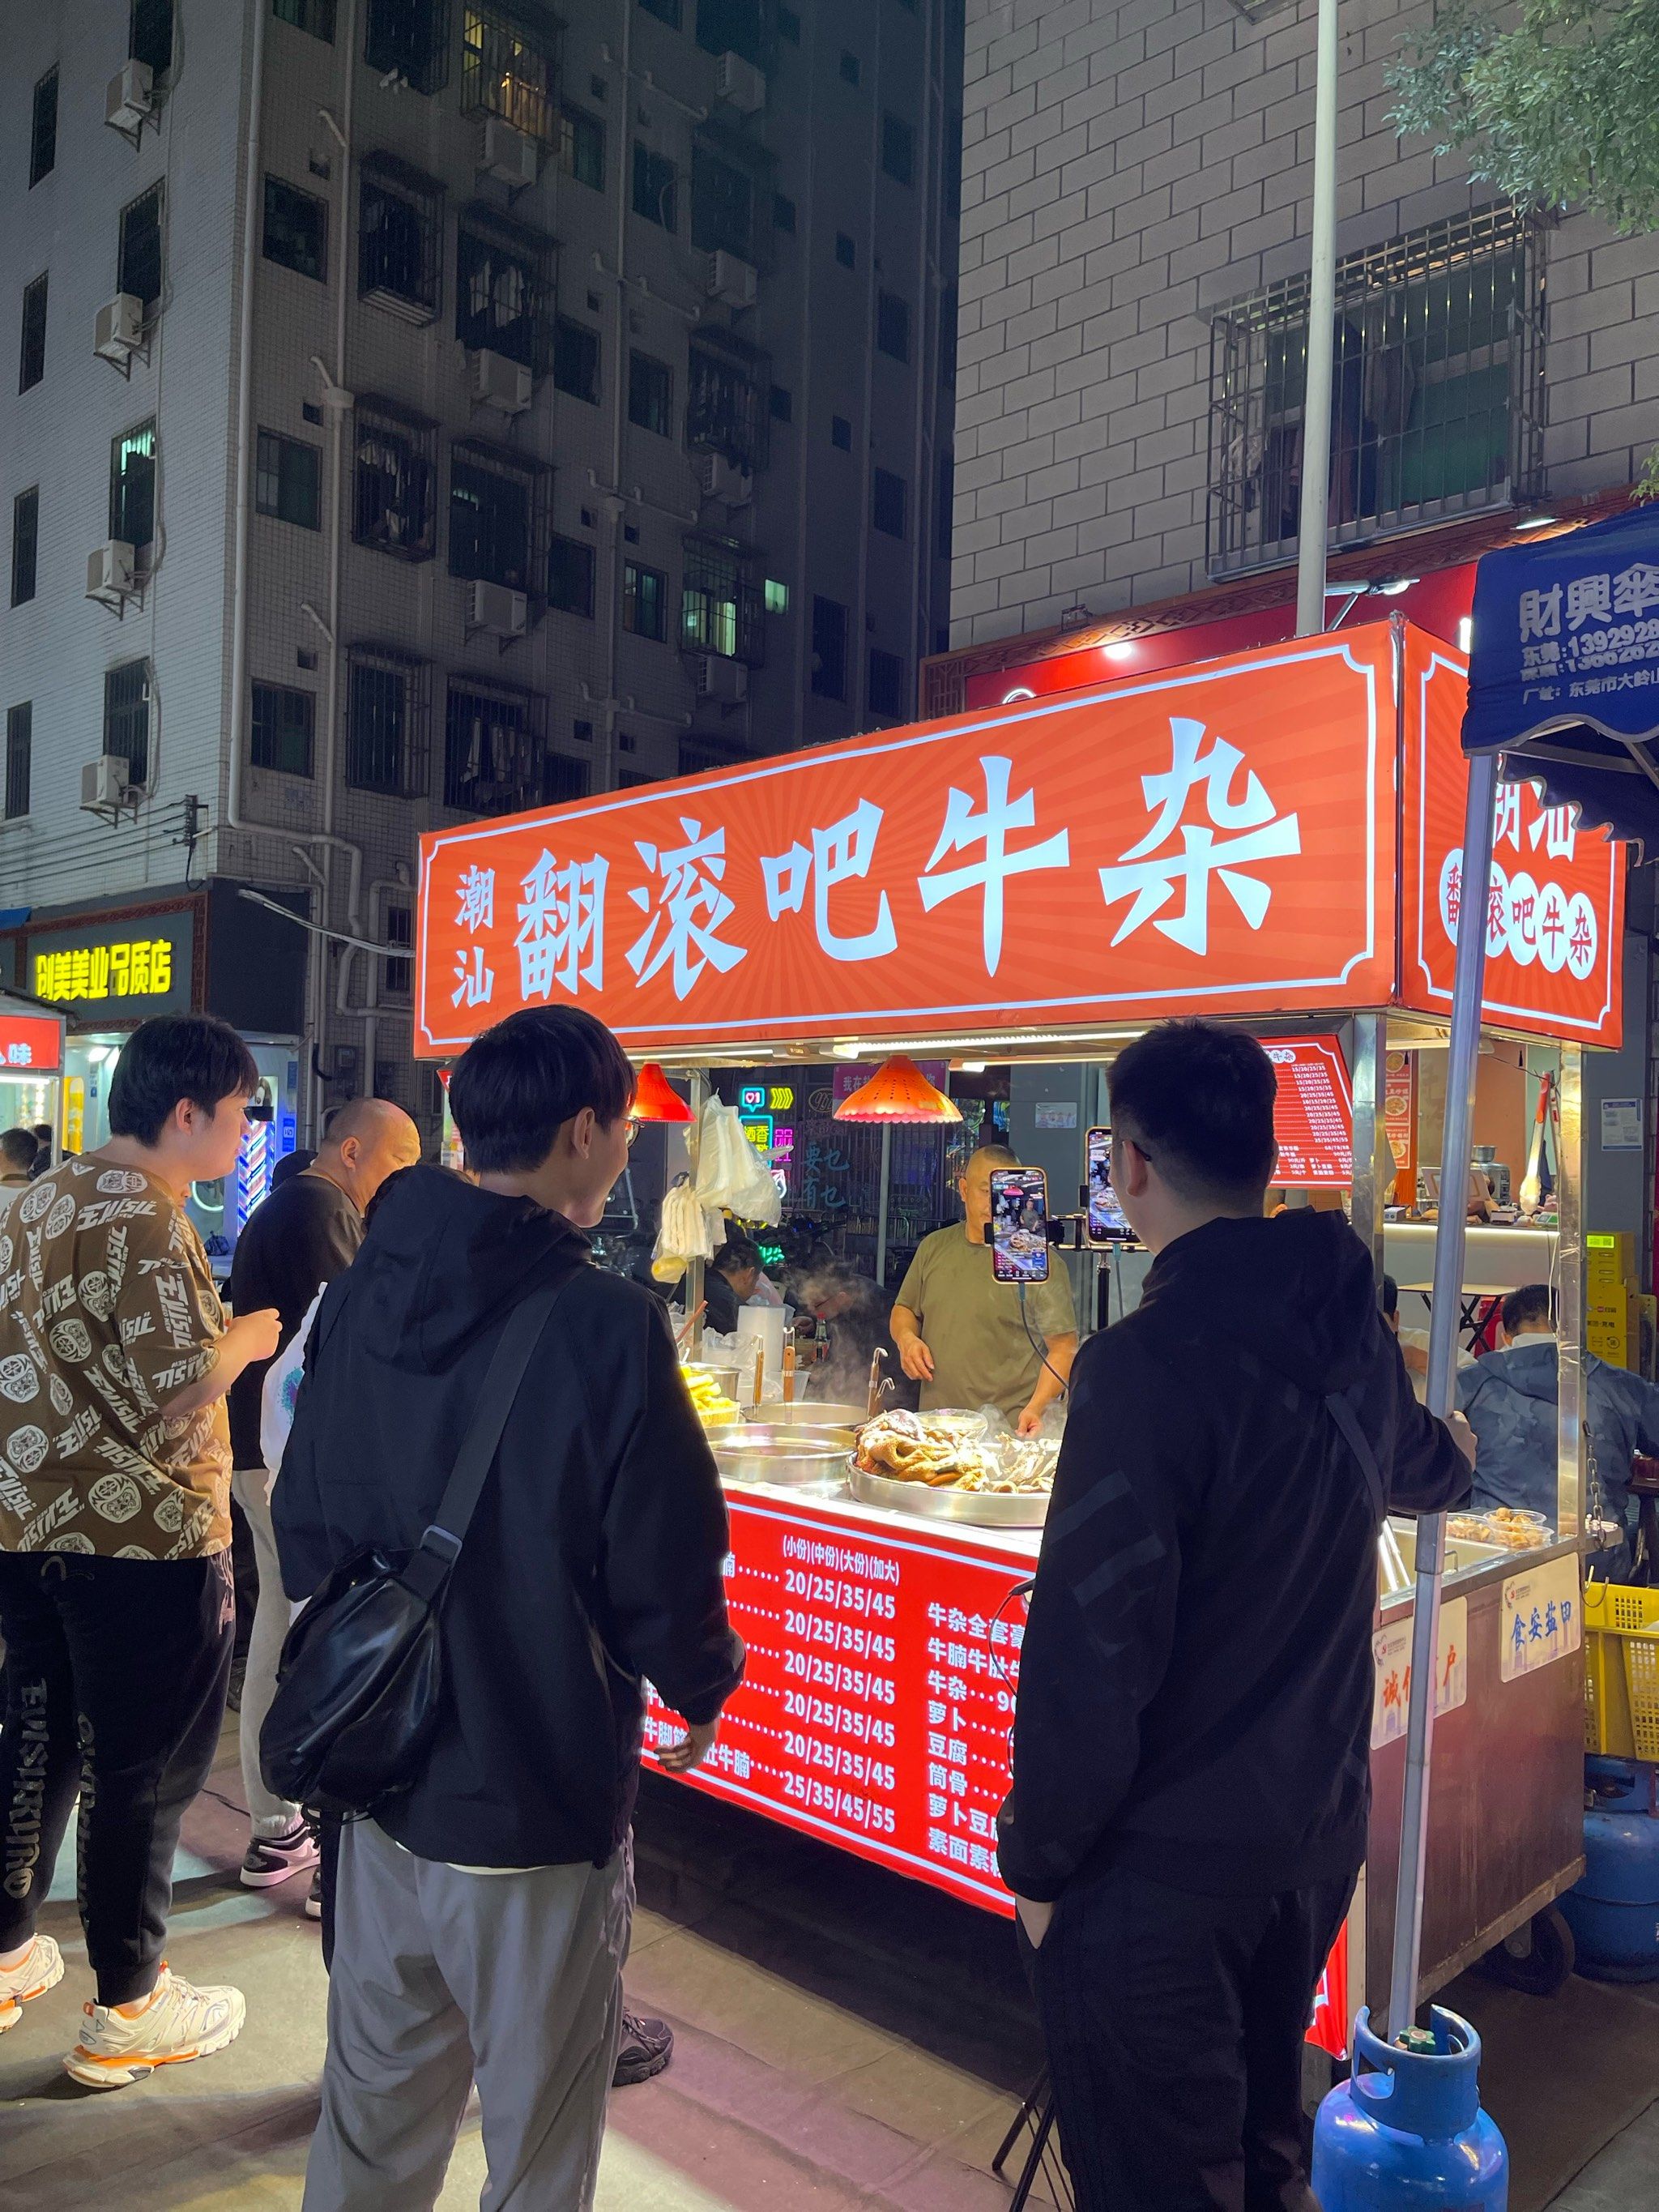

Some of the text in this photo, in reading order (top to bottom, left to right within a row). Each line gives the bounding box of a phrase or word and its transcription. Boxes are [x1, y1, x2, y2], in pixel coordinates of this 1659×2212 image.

[514, 718, 1301, 1001] 翻滚吧牛杂
[452, 865, 496, 1009] 潮汕
[928, 1669, 967, 1701] 牛杂
[928, 1700, 967, 1732] 萝卜
[928, 1731, 968, 1766] 豆腐
[928, 1761, 968, 1798] 筒骨
